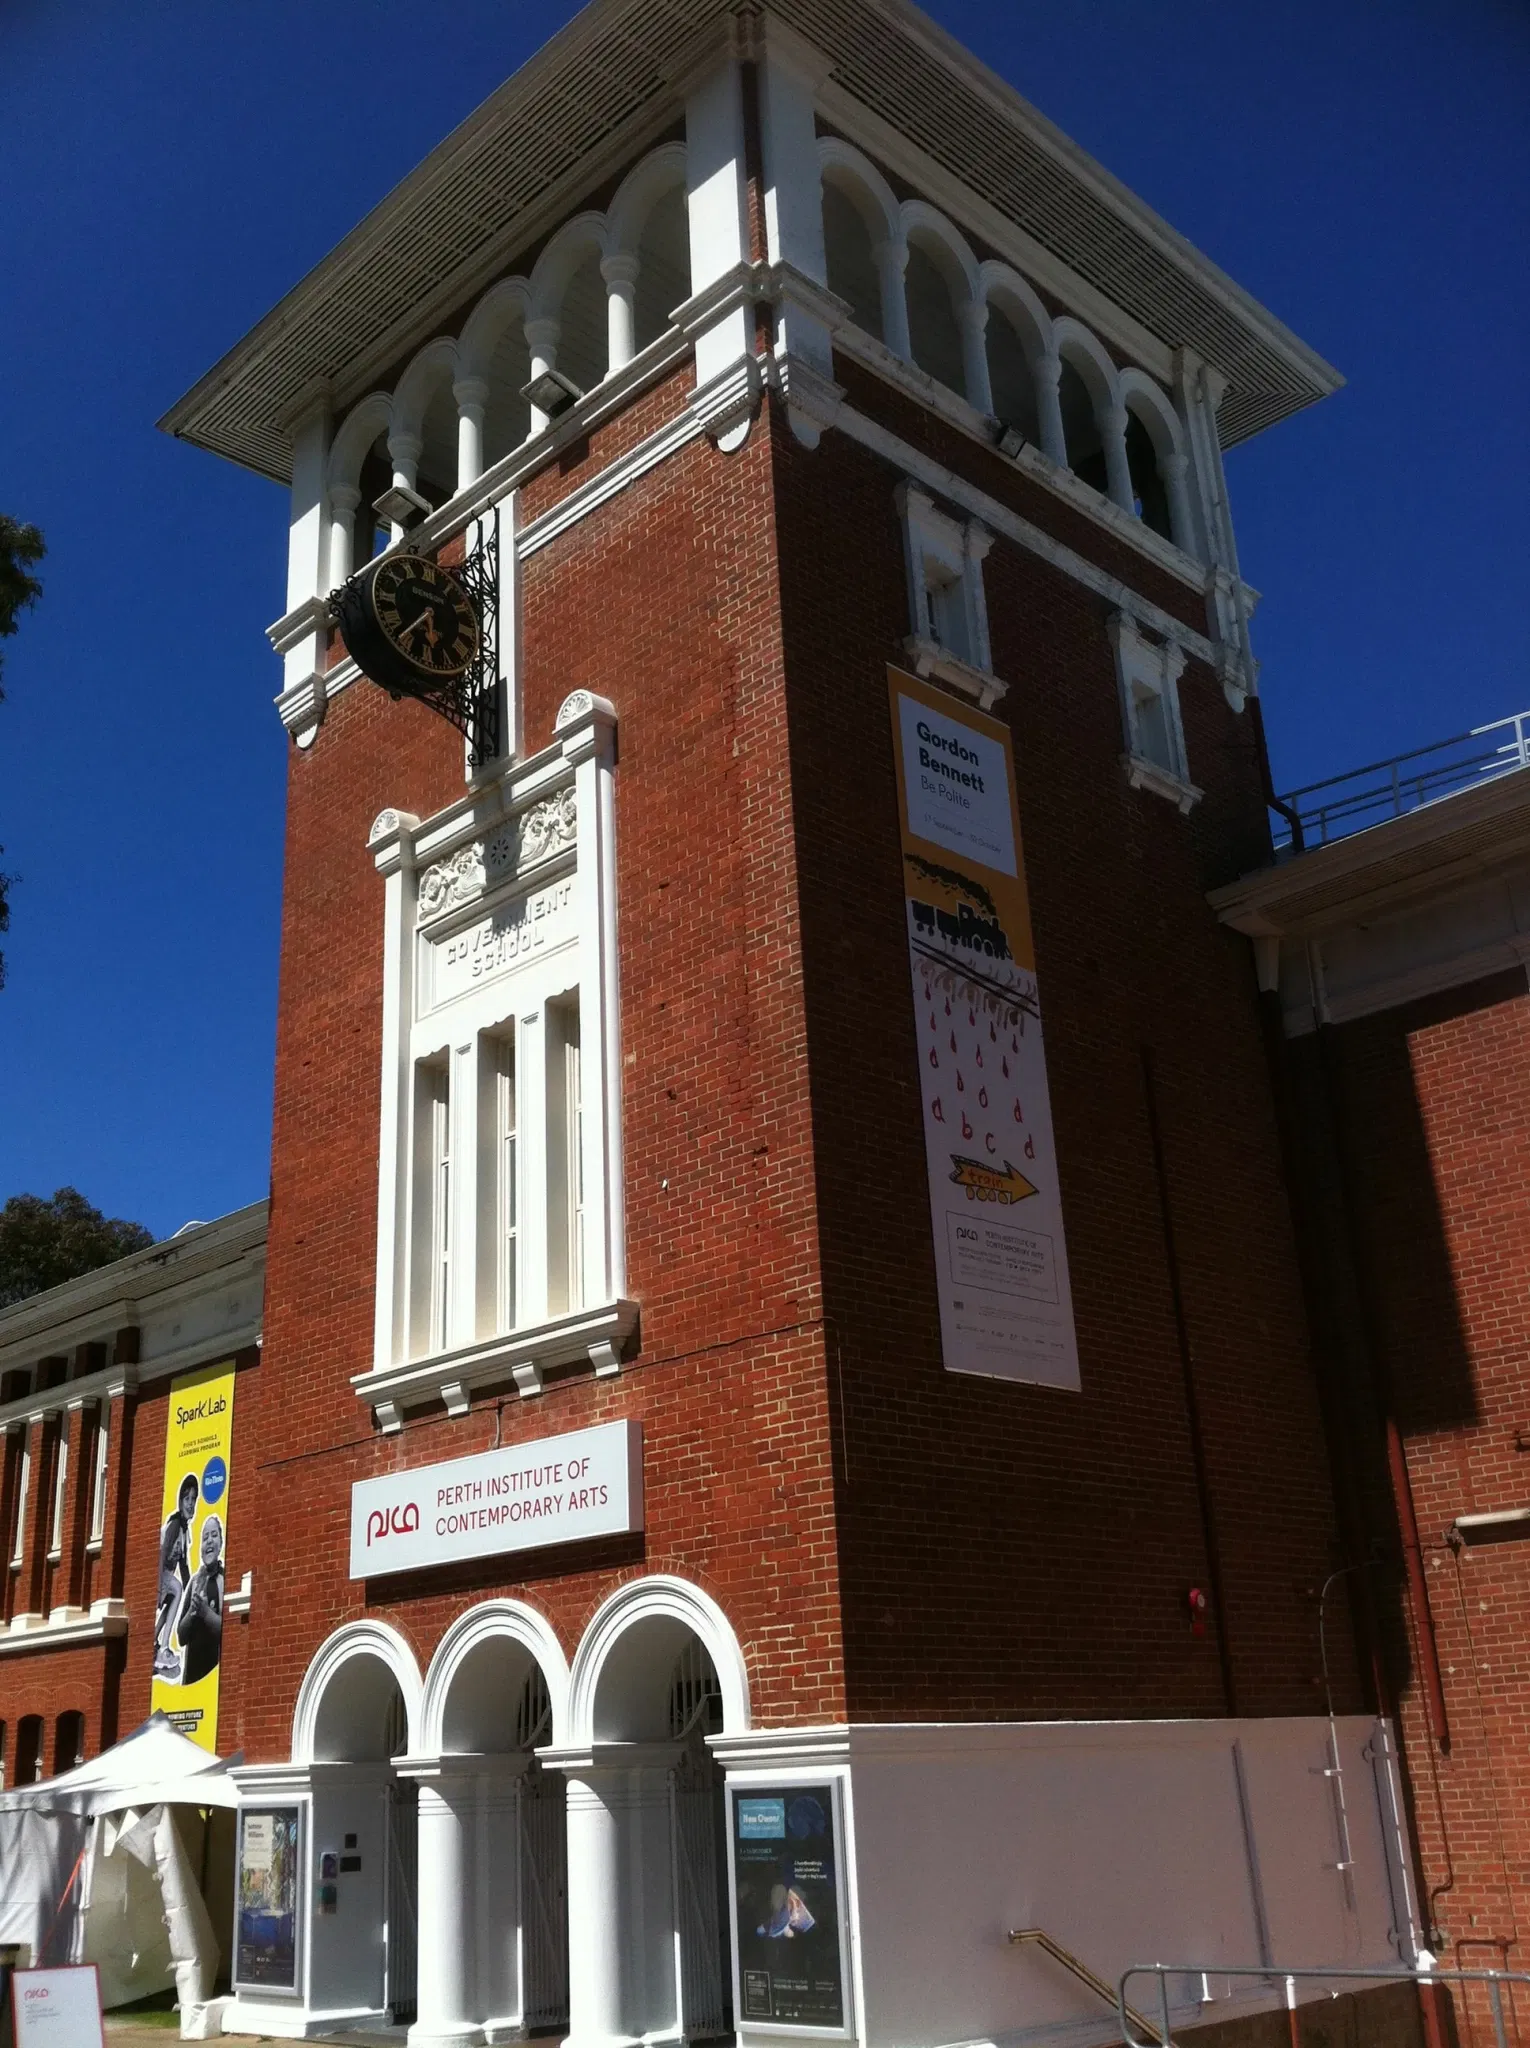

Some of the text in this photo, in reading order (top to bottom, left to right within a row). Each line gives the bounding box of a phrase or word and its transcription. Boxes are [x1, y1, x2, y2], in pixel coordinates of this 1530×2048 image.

[916, 720, 979, 766] Gordon
[919, 747, 985, 794] Bennett
[921, 775, 971, 809] Be Polite
[447, 883, 571, 966] GOVERNMENT
[472, 926, 545, 977] SCHOOL
[967, 1168, 1004, 1189] train
[437, 1457, 591, 1508] PERTH INSTITUTE OF
[435, 1484, 609, 1536] CONTEMPORARY ARTS
